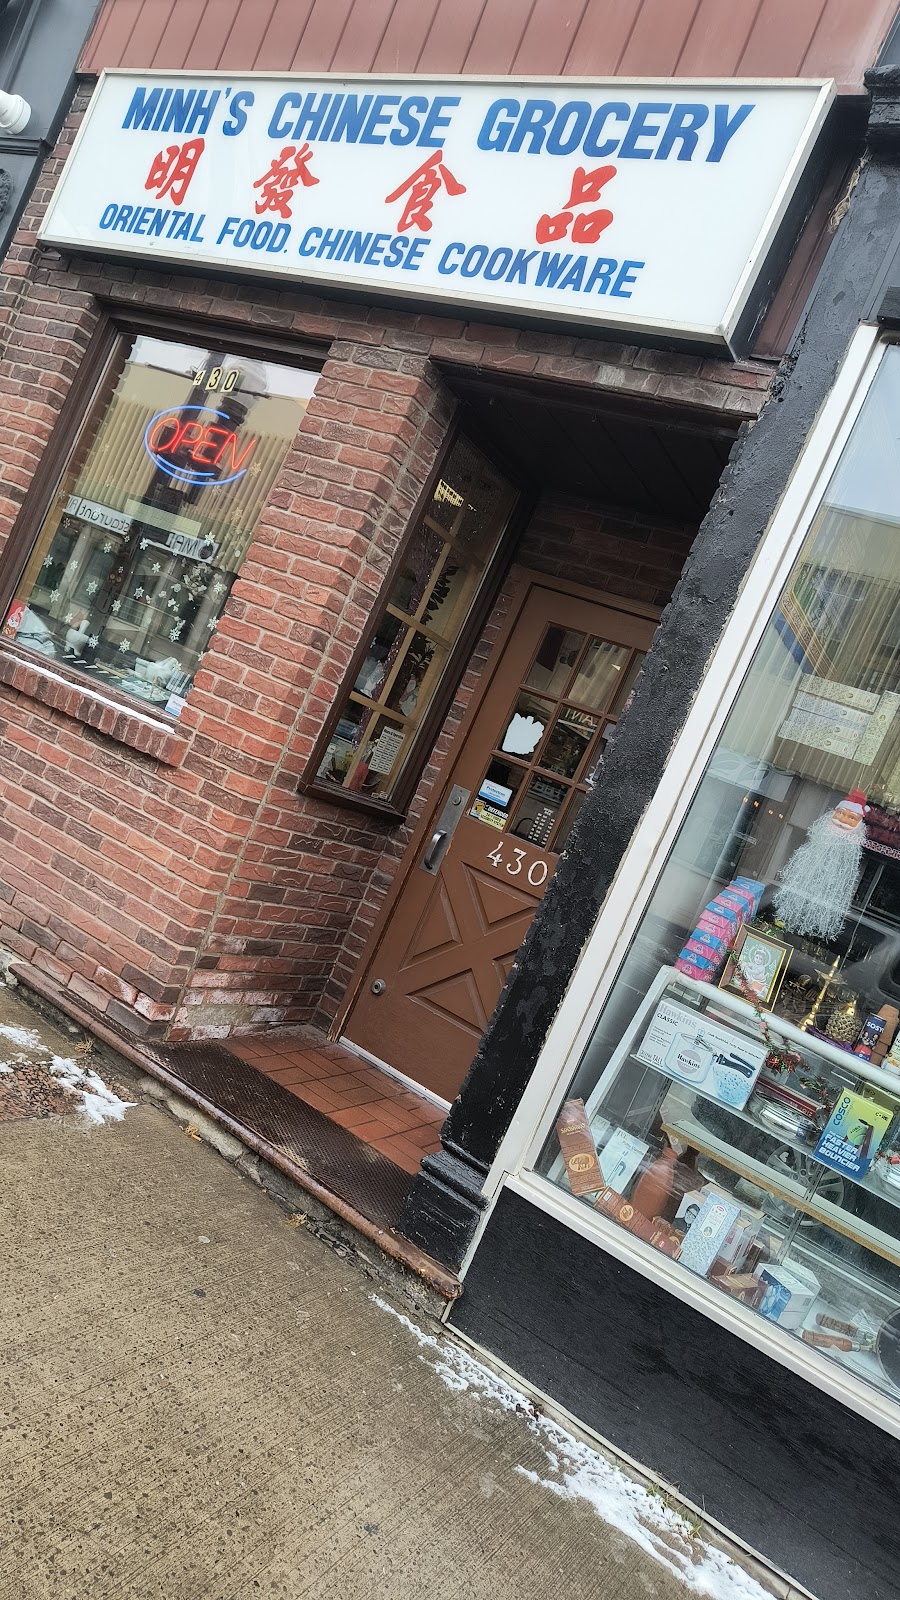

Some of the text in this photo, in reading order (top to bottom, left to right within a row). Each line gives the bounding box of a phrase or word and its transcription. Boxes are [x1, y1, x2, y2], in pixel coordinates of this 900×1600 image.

[122, 87, 756, 163] MINH'S CHINESE GROCERY
[98, 203, 206, 243] ORIENTAL
[298, 226, 432, 272] CHINESE
[437, 241, 646, 299] COOKWARE
[193, 367, 239, 391] 430
[150, 416, 257, 470] OPEN
[486, 841, 548, 887] 430
[660, 1003, 698, 1030] Hawkins
[833, 1096, 851, 1126] COSCO
[821, 1140, 857, 1162] HEAVIER
[824, 1133, 859, 1155] FASTER
[818, 1146, 861, 1172] BOUNCIER
